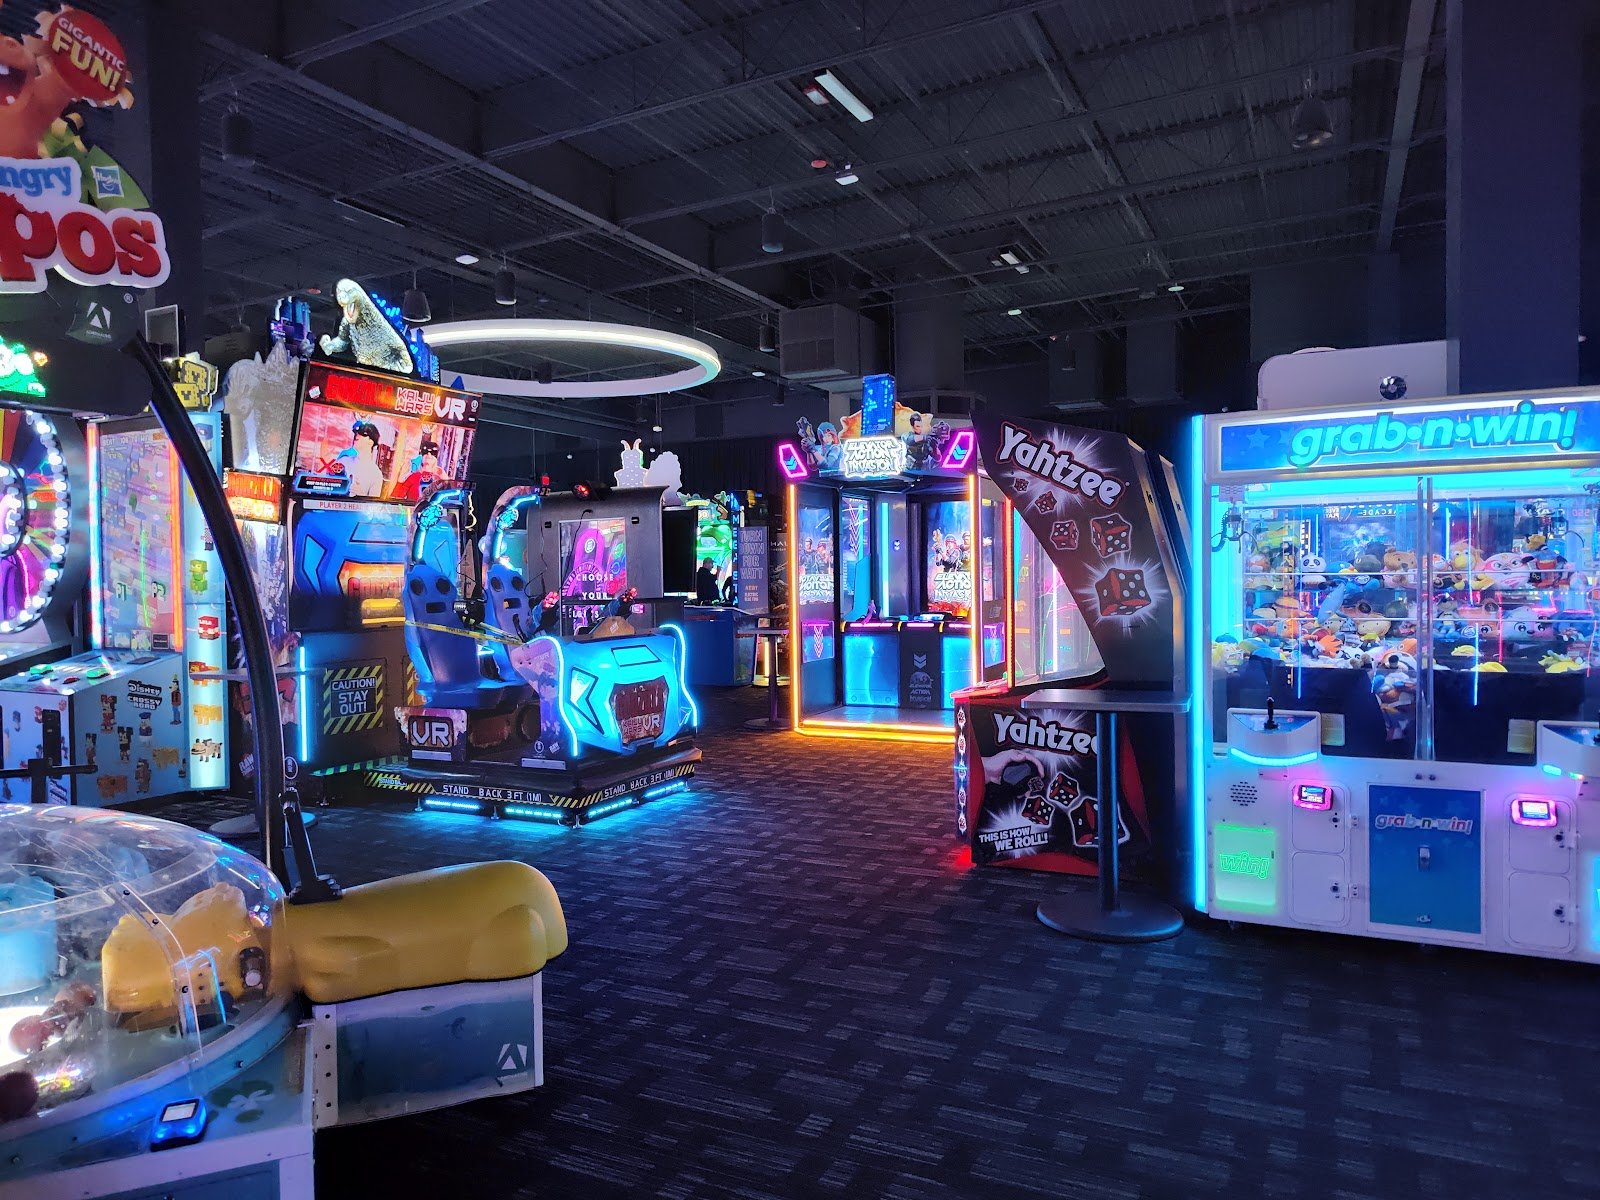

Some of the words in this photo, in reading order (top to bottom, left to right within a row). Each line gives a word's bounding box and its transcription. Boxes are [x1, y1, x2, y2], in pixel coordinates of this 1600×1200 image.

[58, 17, 125, 71] GIGANTIC
[51, 28, 121, 92] FUN!
[397, 387, 435, 402] KAIJU
[395, 400, 433, 416] WARS
[434, 396, 466, 421] VR
[998, 425, 1122, 506] Yahtzee
[319, 501, 341, 509] PLAYER
[740, 530, 763, 543] TURN
[576, 573, 614, 582] CHOOSE
[582, 592, 608, 600] YOUR
[332, 678, 375, 690] CAUTION!
[339, 690, 369, 704] STAY
[340, 702, 367, 715] OUT!
[412, 720, 449, 746] VR
[443, 784, 469, 795] STAND
[478, 788, 502, 798] BACK
[604, 783, 626, 797] STAND
[630, 777, 648, 789] BACK
[979, 832, 999, 843] THIS
[1000, 830, 1009, 840] IS
[1009, 827, 1031, 838] HOW
[995, 839, 1013, 852] WE
[1014, 832, 1049, 849] ROLL!
[1219, 850, 1270, 880] win!
